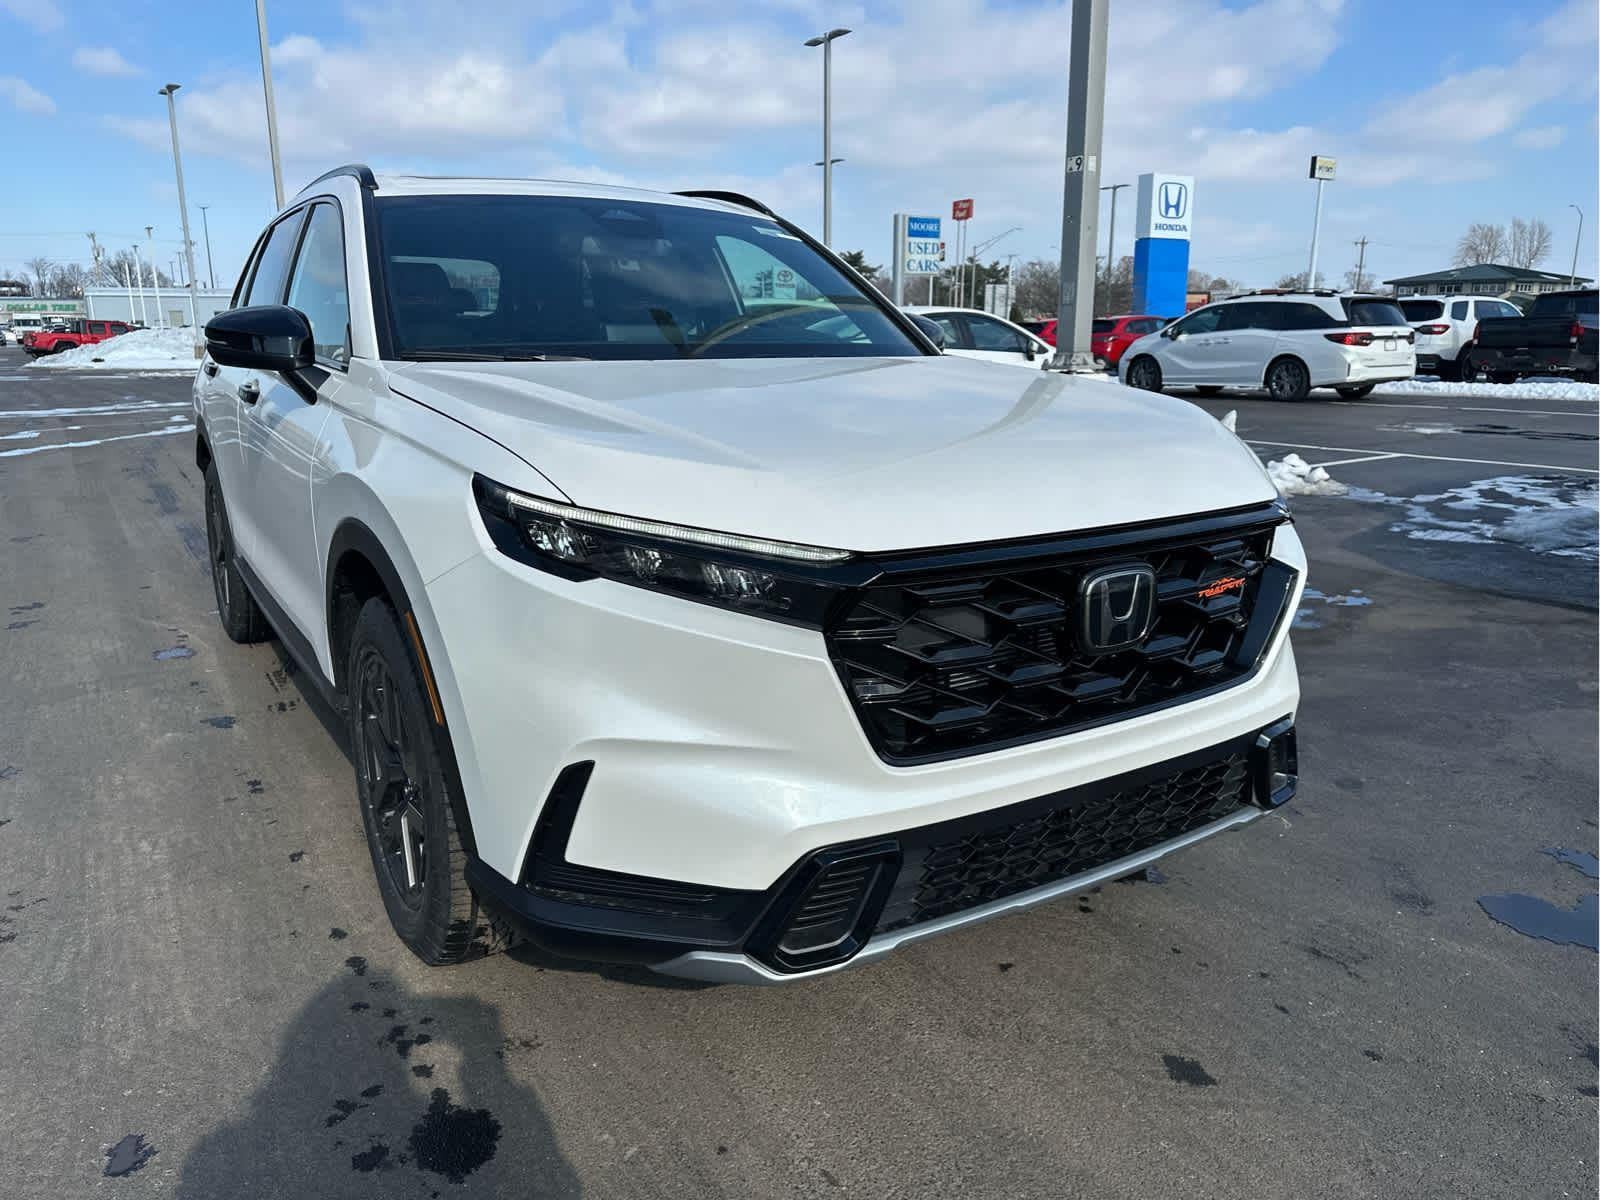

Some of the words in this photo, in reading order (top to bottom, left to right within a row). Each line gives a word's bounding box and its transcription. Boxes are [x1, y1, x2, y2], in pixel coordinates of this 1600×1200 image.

[909, 222, 939, 232] MOORE
[1154, 223, 1188, 232] HONDA
[908, 242, 939, 255] USED
[906, 259, 939, 272] CARS
[6, 304, 48, 312] DOLLAR
